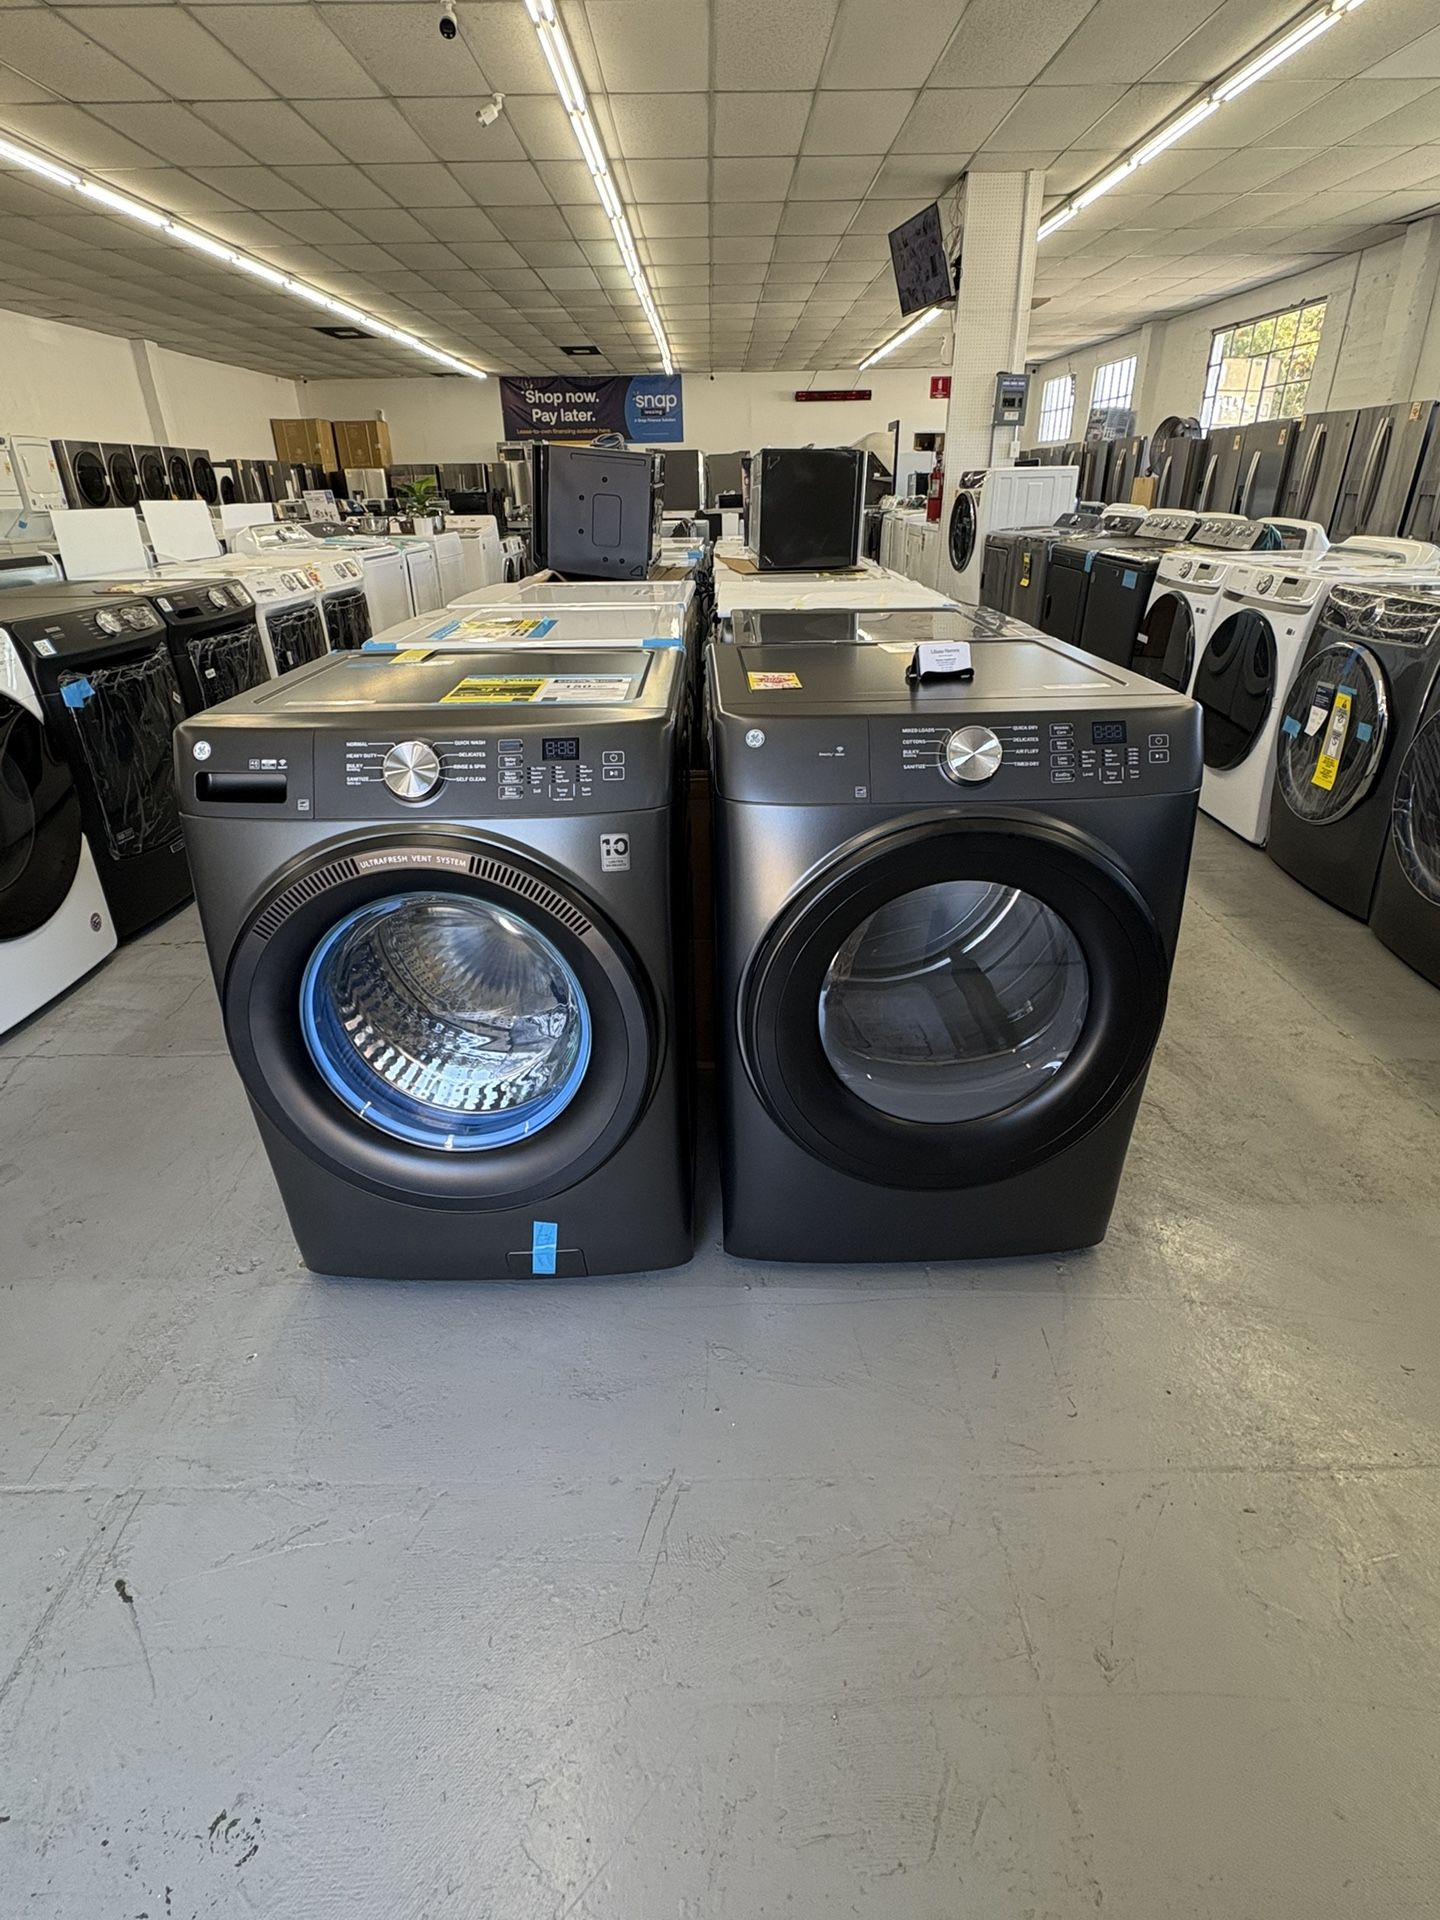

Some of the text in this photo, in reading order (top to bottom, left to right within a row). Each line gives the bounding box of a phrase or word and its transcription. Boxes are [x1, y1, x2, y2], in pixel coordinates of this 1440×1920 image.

[525, 390, 600, 406] Shop now.
[635, 394, 678, 412] snap
[532, 408, 597, 426] Pay later.
[360, 855, 467, 869] ULTRAFRESH VENT SYSTEM
